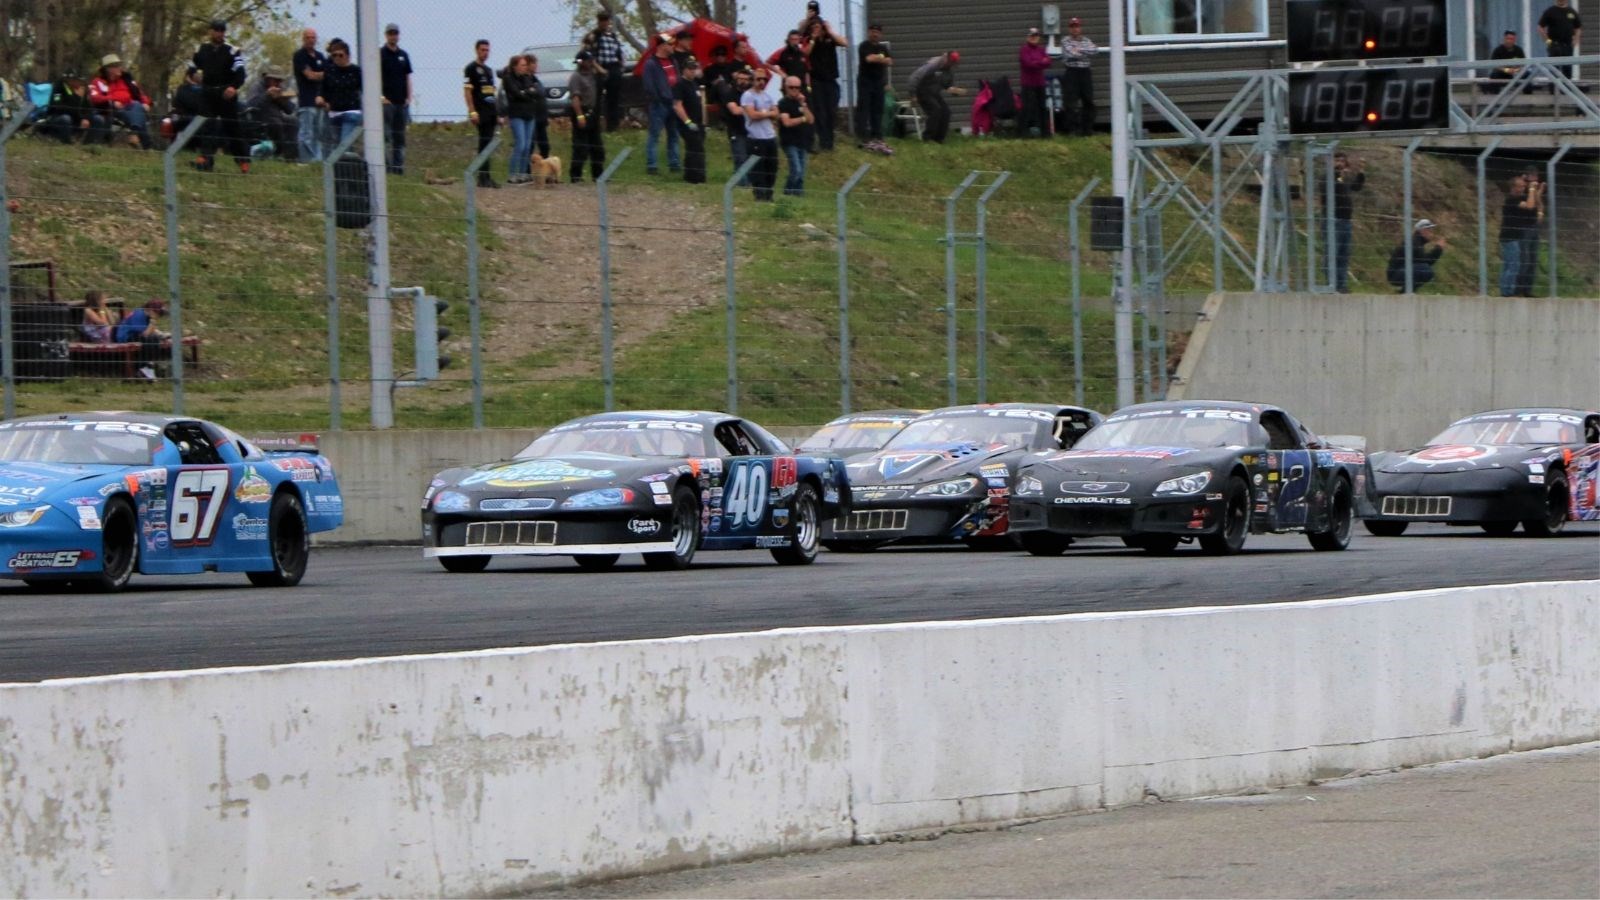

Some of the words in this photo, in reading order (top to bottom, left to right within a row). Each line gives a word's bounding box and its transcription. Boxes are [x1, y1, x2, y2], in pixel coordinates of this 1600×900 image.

[169, 468, 230, 542] 67
[727, 464, 767, 527] 40
[1115, 497, 1131, 505] SS
[52, 551, 81, 567] ES
